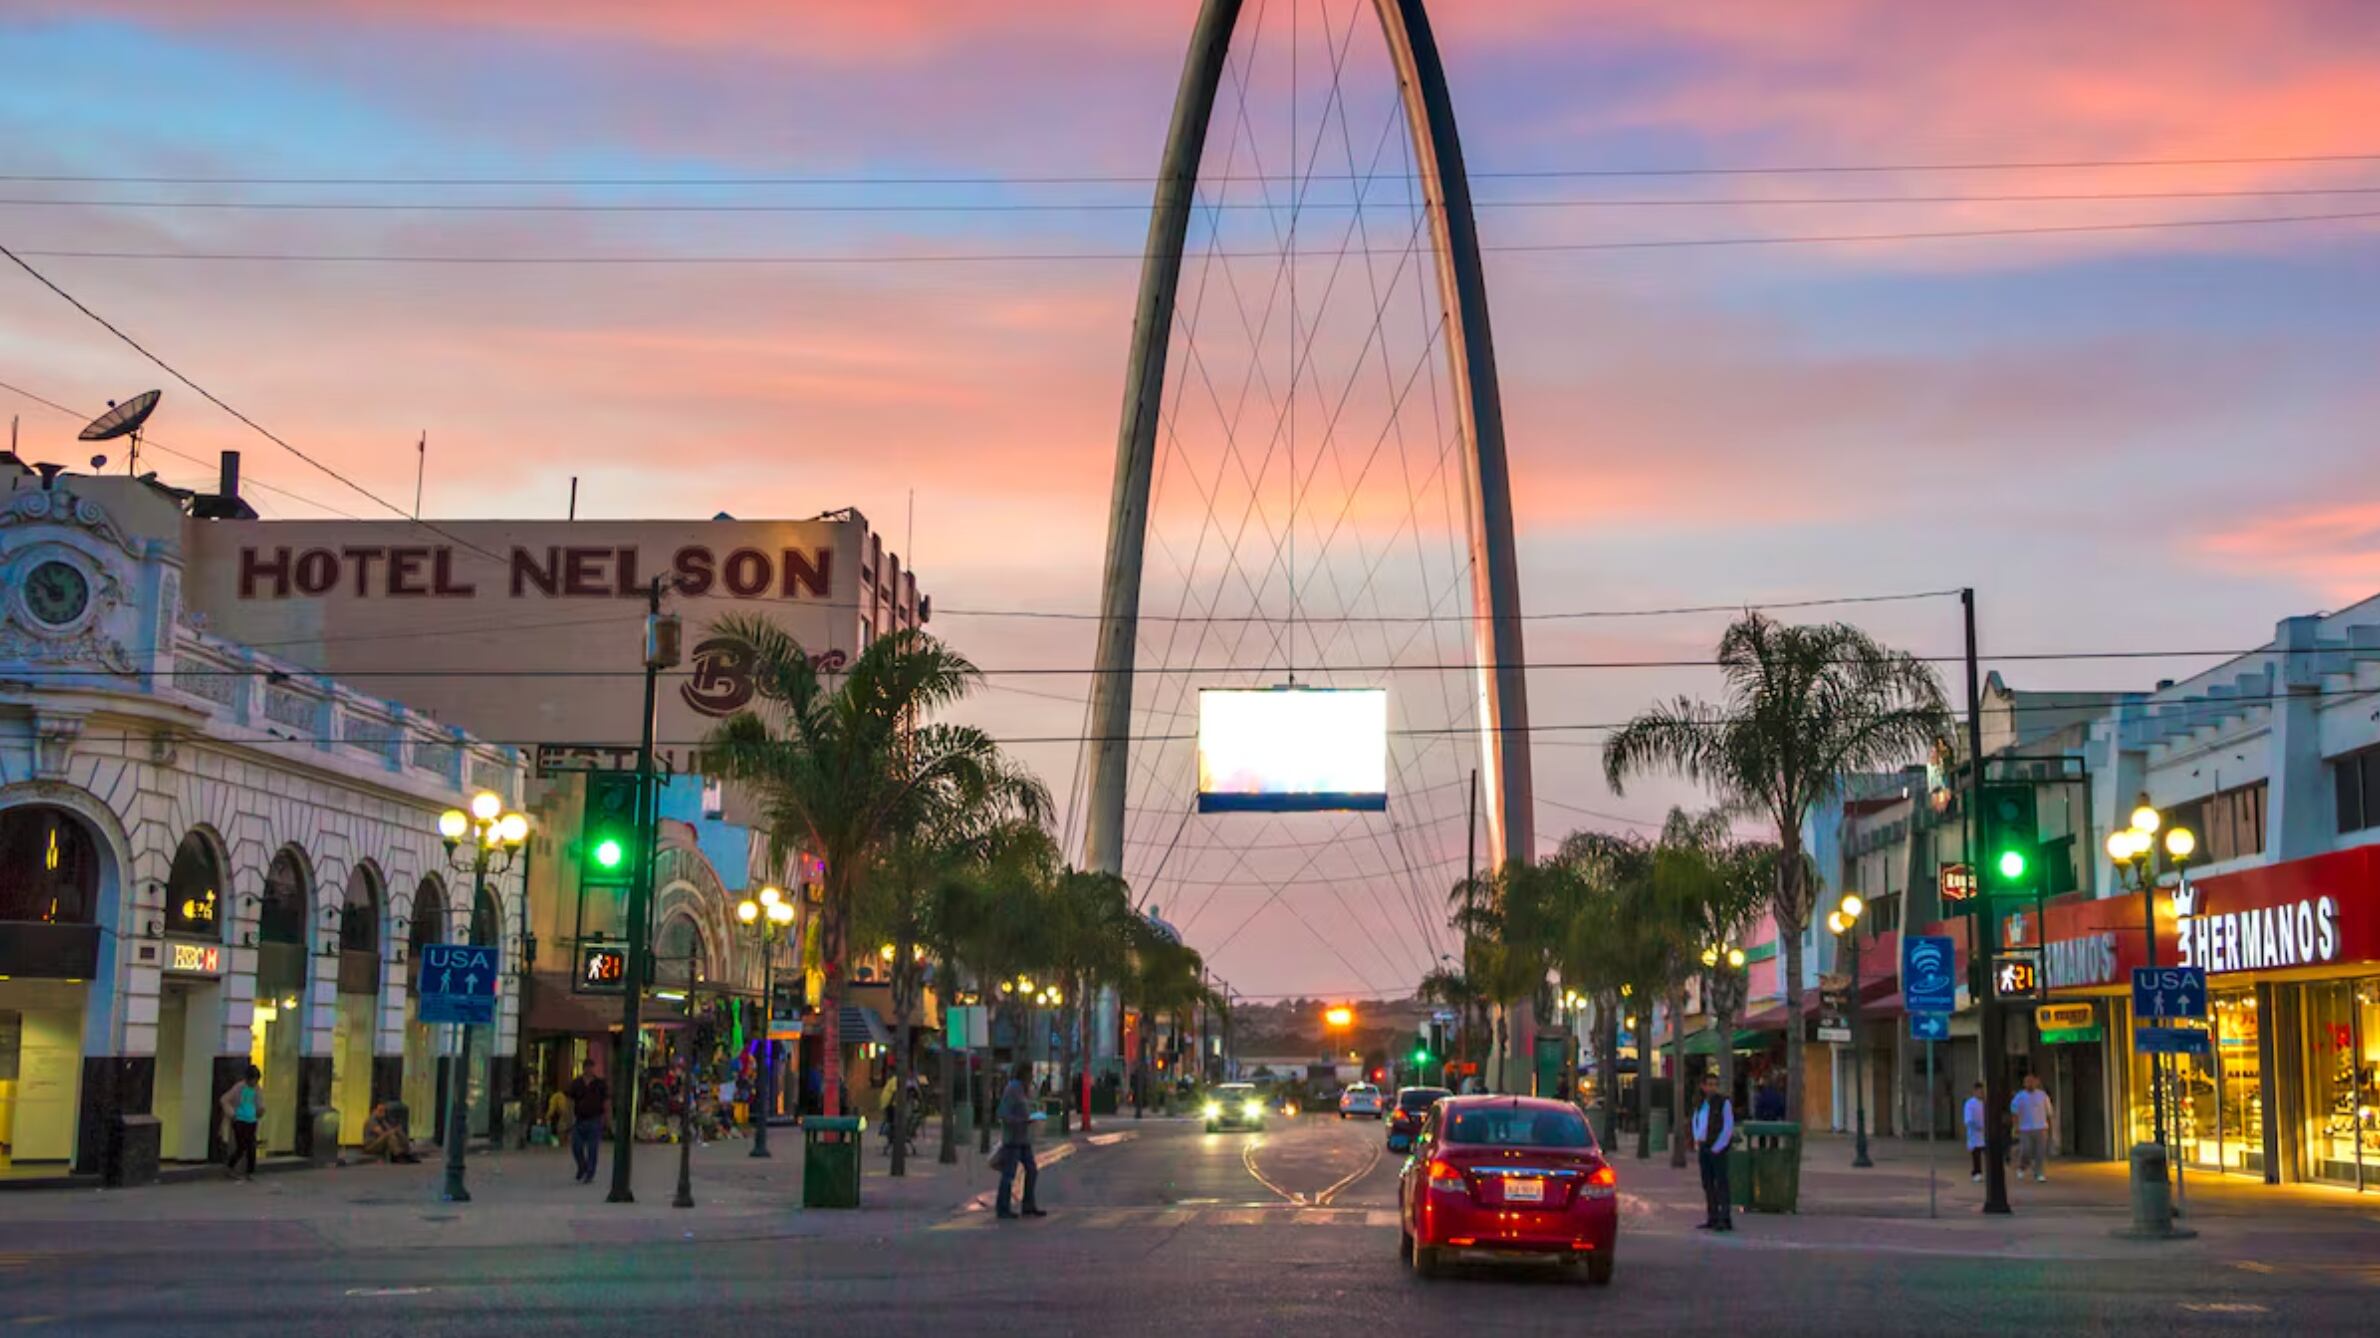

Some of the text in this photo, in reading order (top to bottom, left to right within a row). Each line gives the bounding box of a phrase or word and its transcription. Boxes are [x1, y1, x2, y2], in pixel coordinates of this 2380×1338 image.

[239, 545, 834, 598] HOTEL NELSON
[2177, 896, 2335, 972] 3 HERMANOS
[430, 949, 489, 970] USA
[601, 954, 620, 979] 21
[2015, 965, 2034, 990] 21
[2140, 971, 2199, 990] USA
